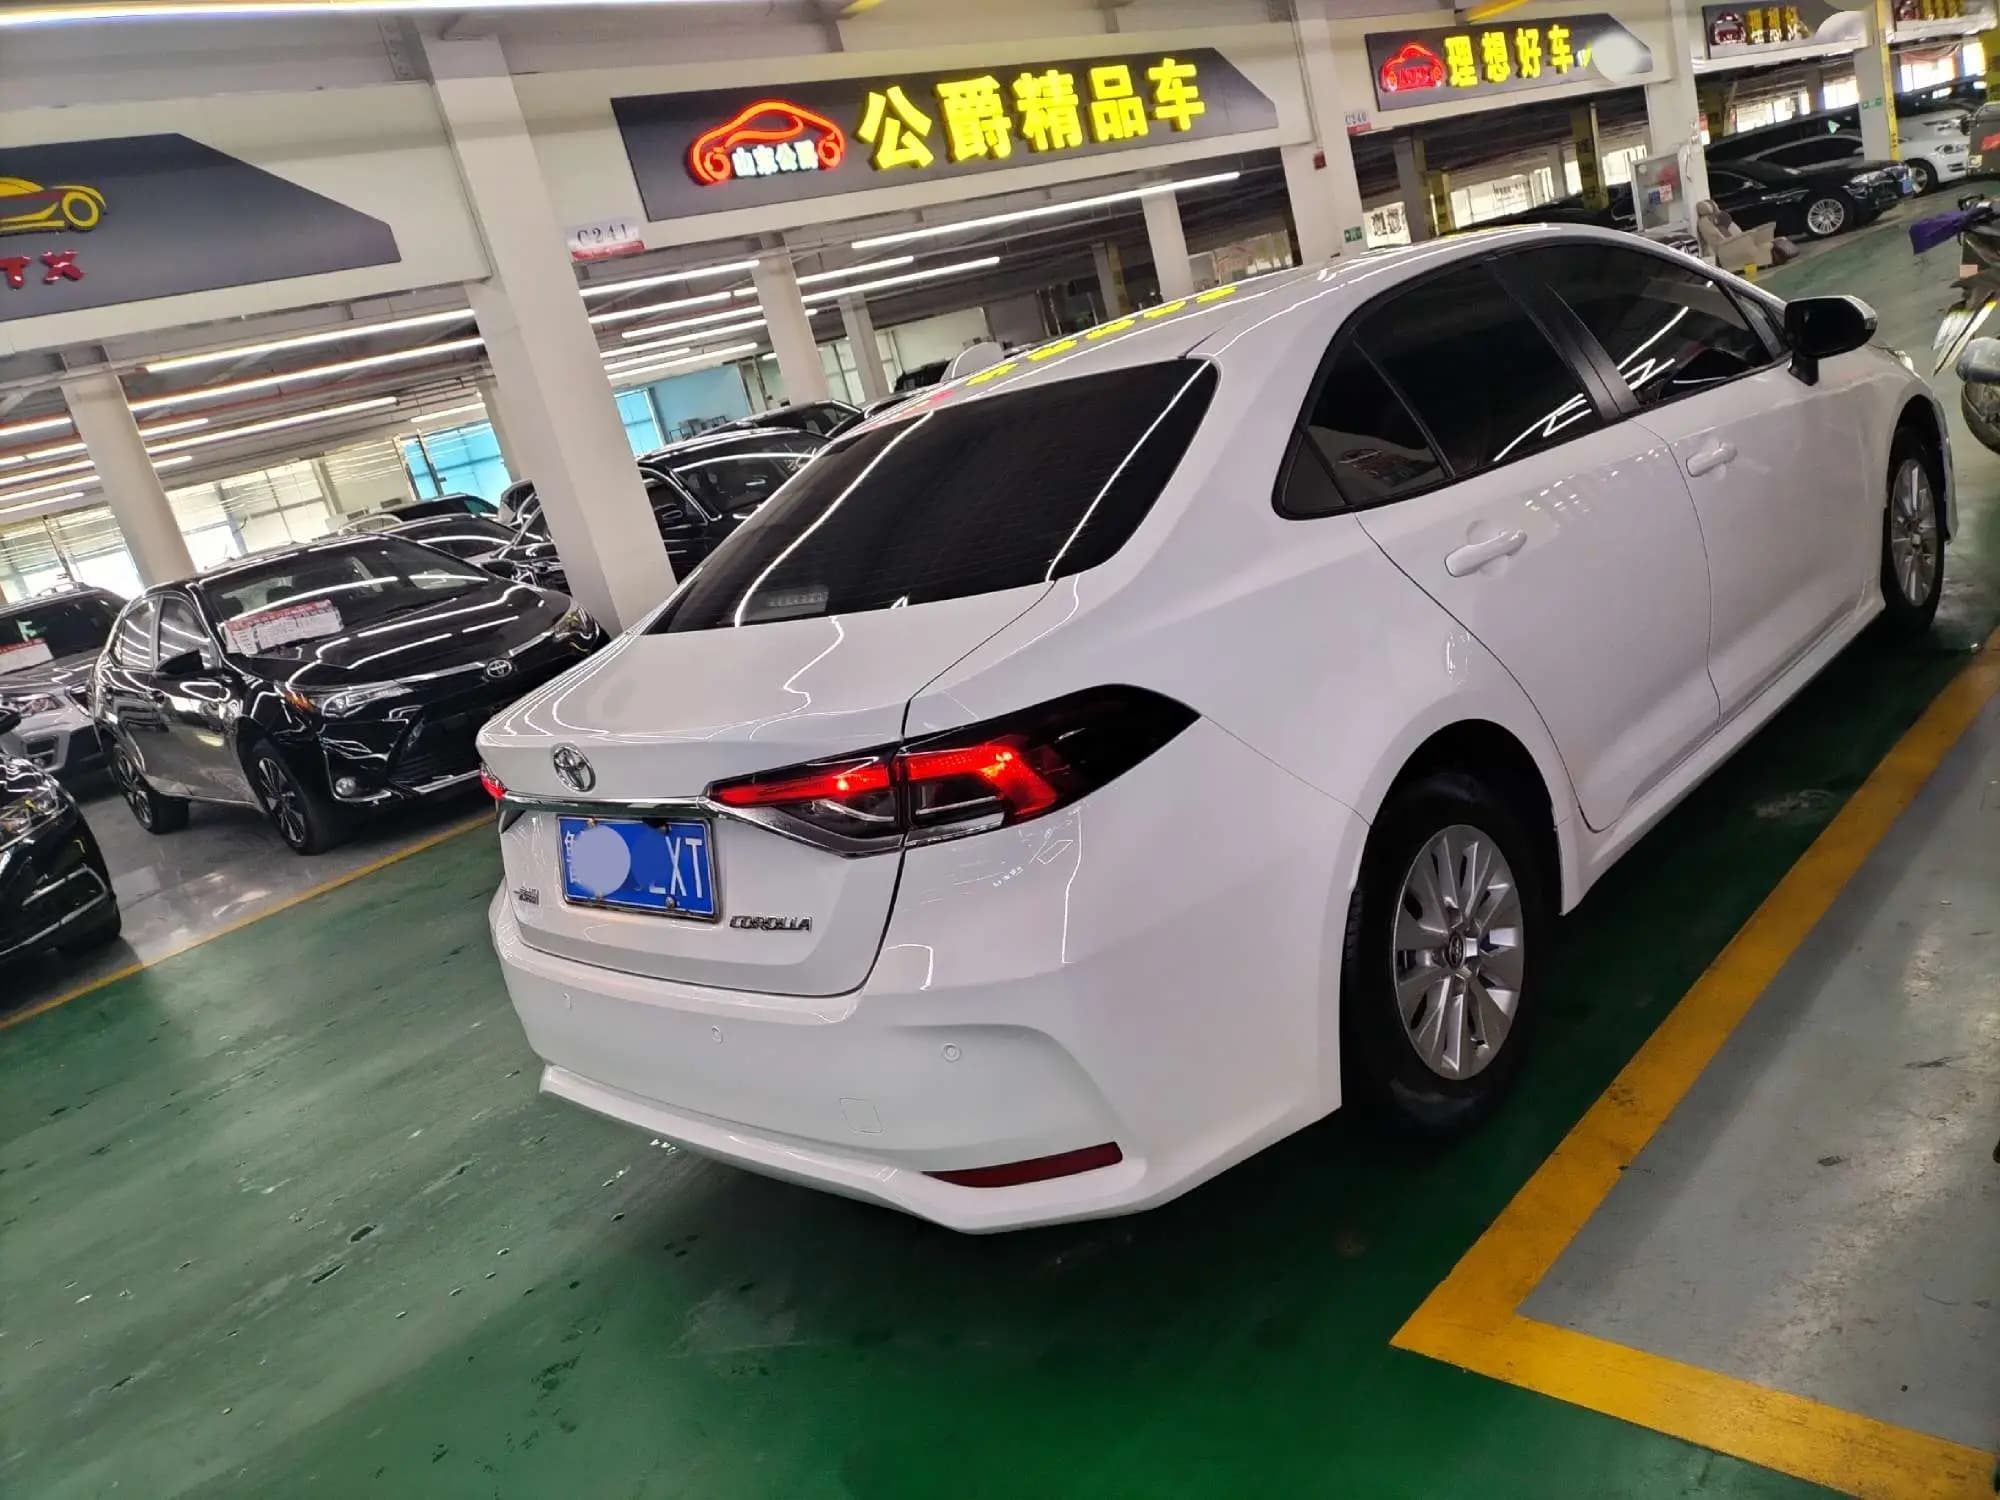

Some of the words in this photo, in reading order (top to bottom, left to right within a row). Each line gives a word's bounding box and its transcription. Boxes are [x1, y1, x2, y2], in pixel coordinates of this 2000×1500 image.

[1443, 24, 1574, 87] 理想好车
[857, 58, 1205, 169] 公爵精品车
[577, 223, 627, 245] C241
[729, 914, 812, 932] COROLLA
